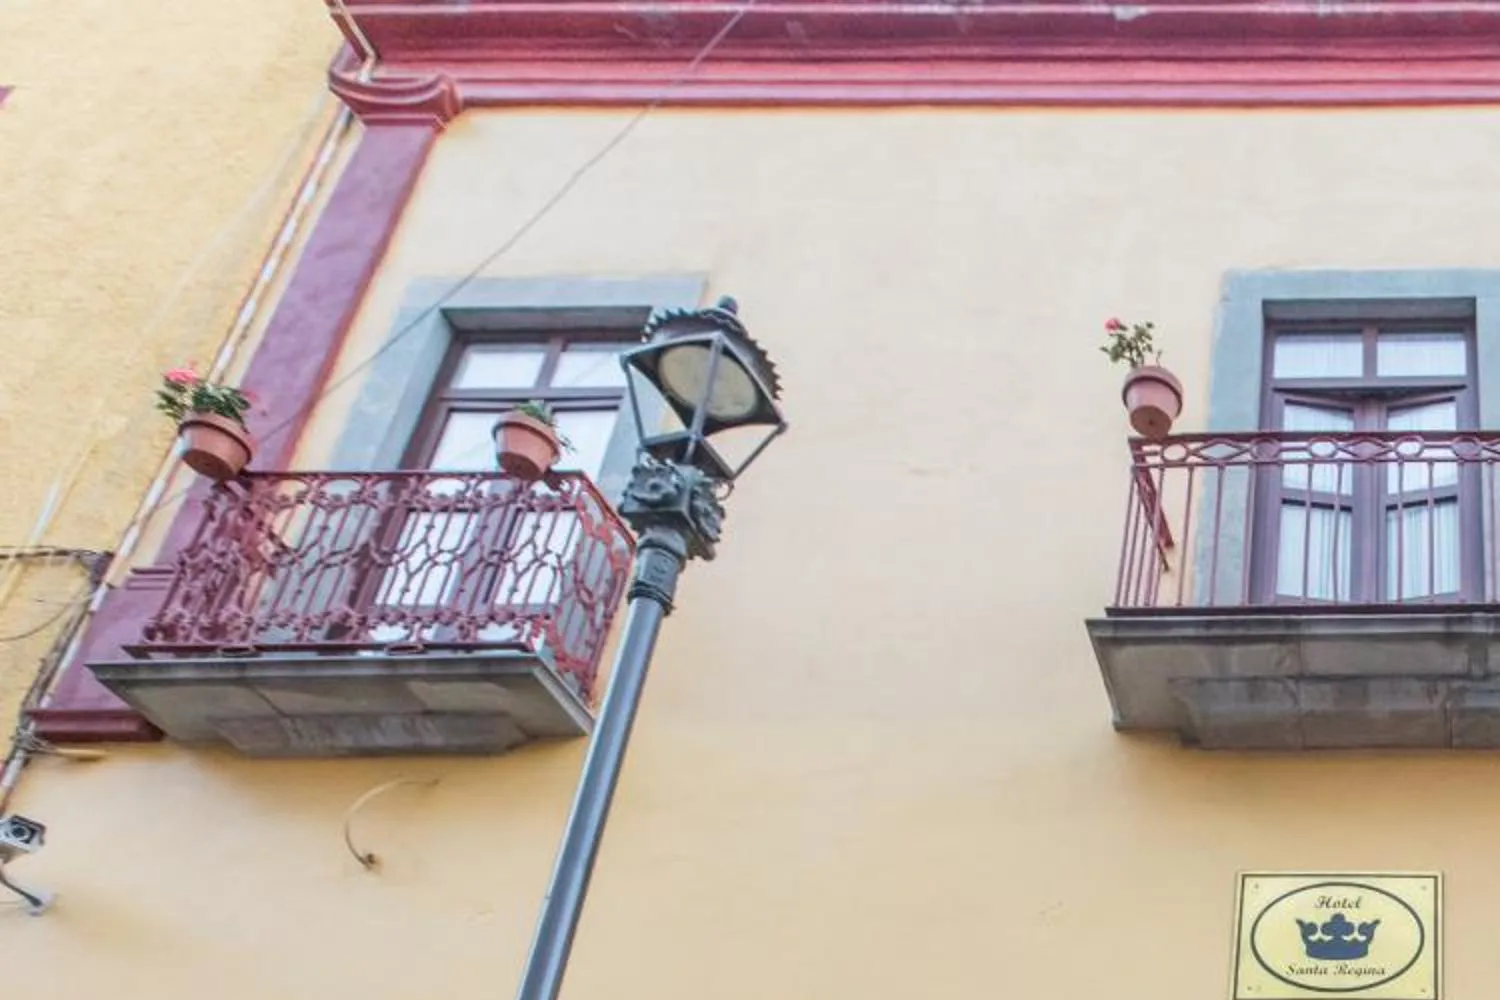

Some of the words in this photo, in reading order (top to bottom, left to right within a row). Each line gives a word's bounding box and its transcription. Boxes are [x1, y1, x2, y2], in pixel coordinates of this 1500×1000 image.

[1314, 895, 1362, 910] Hotel
[1285, 963, 1328, 976] Santa
[1333, 963, 1386, 977] Regina
